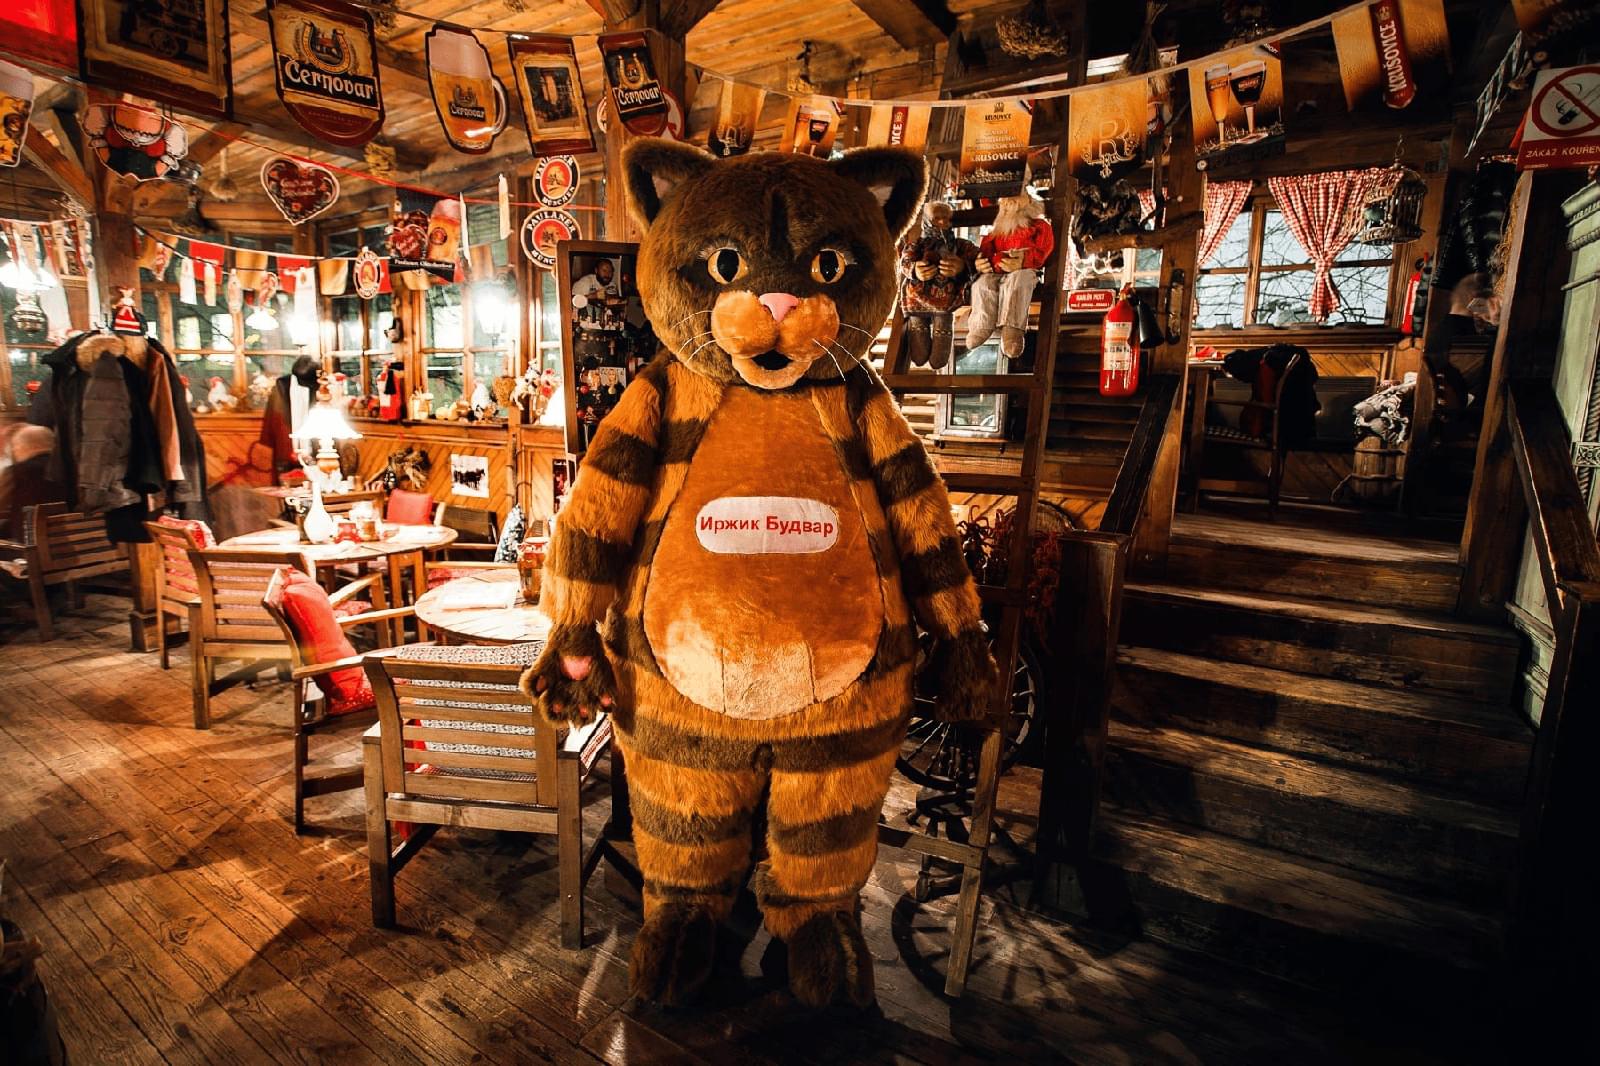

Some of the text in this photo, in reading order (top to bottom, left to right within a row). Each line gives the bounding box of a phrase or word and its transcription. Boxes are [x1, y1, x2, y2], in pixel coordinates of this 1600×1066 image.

[1379, 20, 1407, 92] KRUŠOVICE
[526, 211, 576, 232] PAULANER
[701, 516, 834, 538] Иржик Будвар
